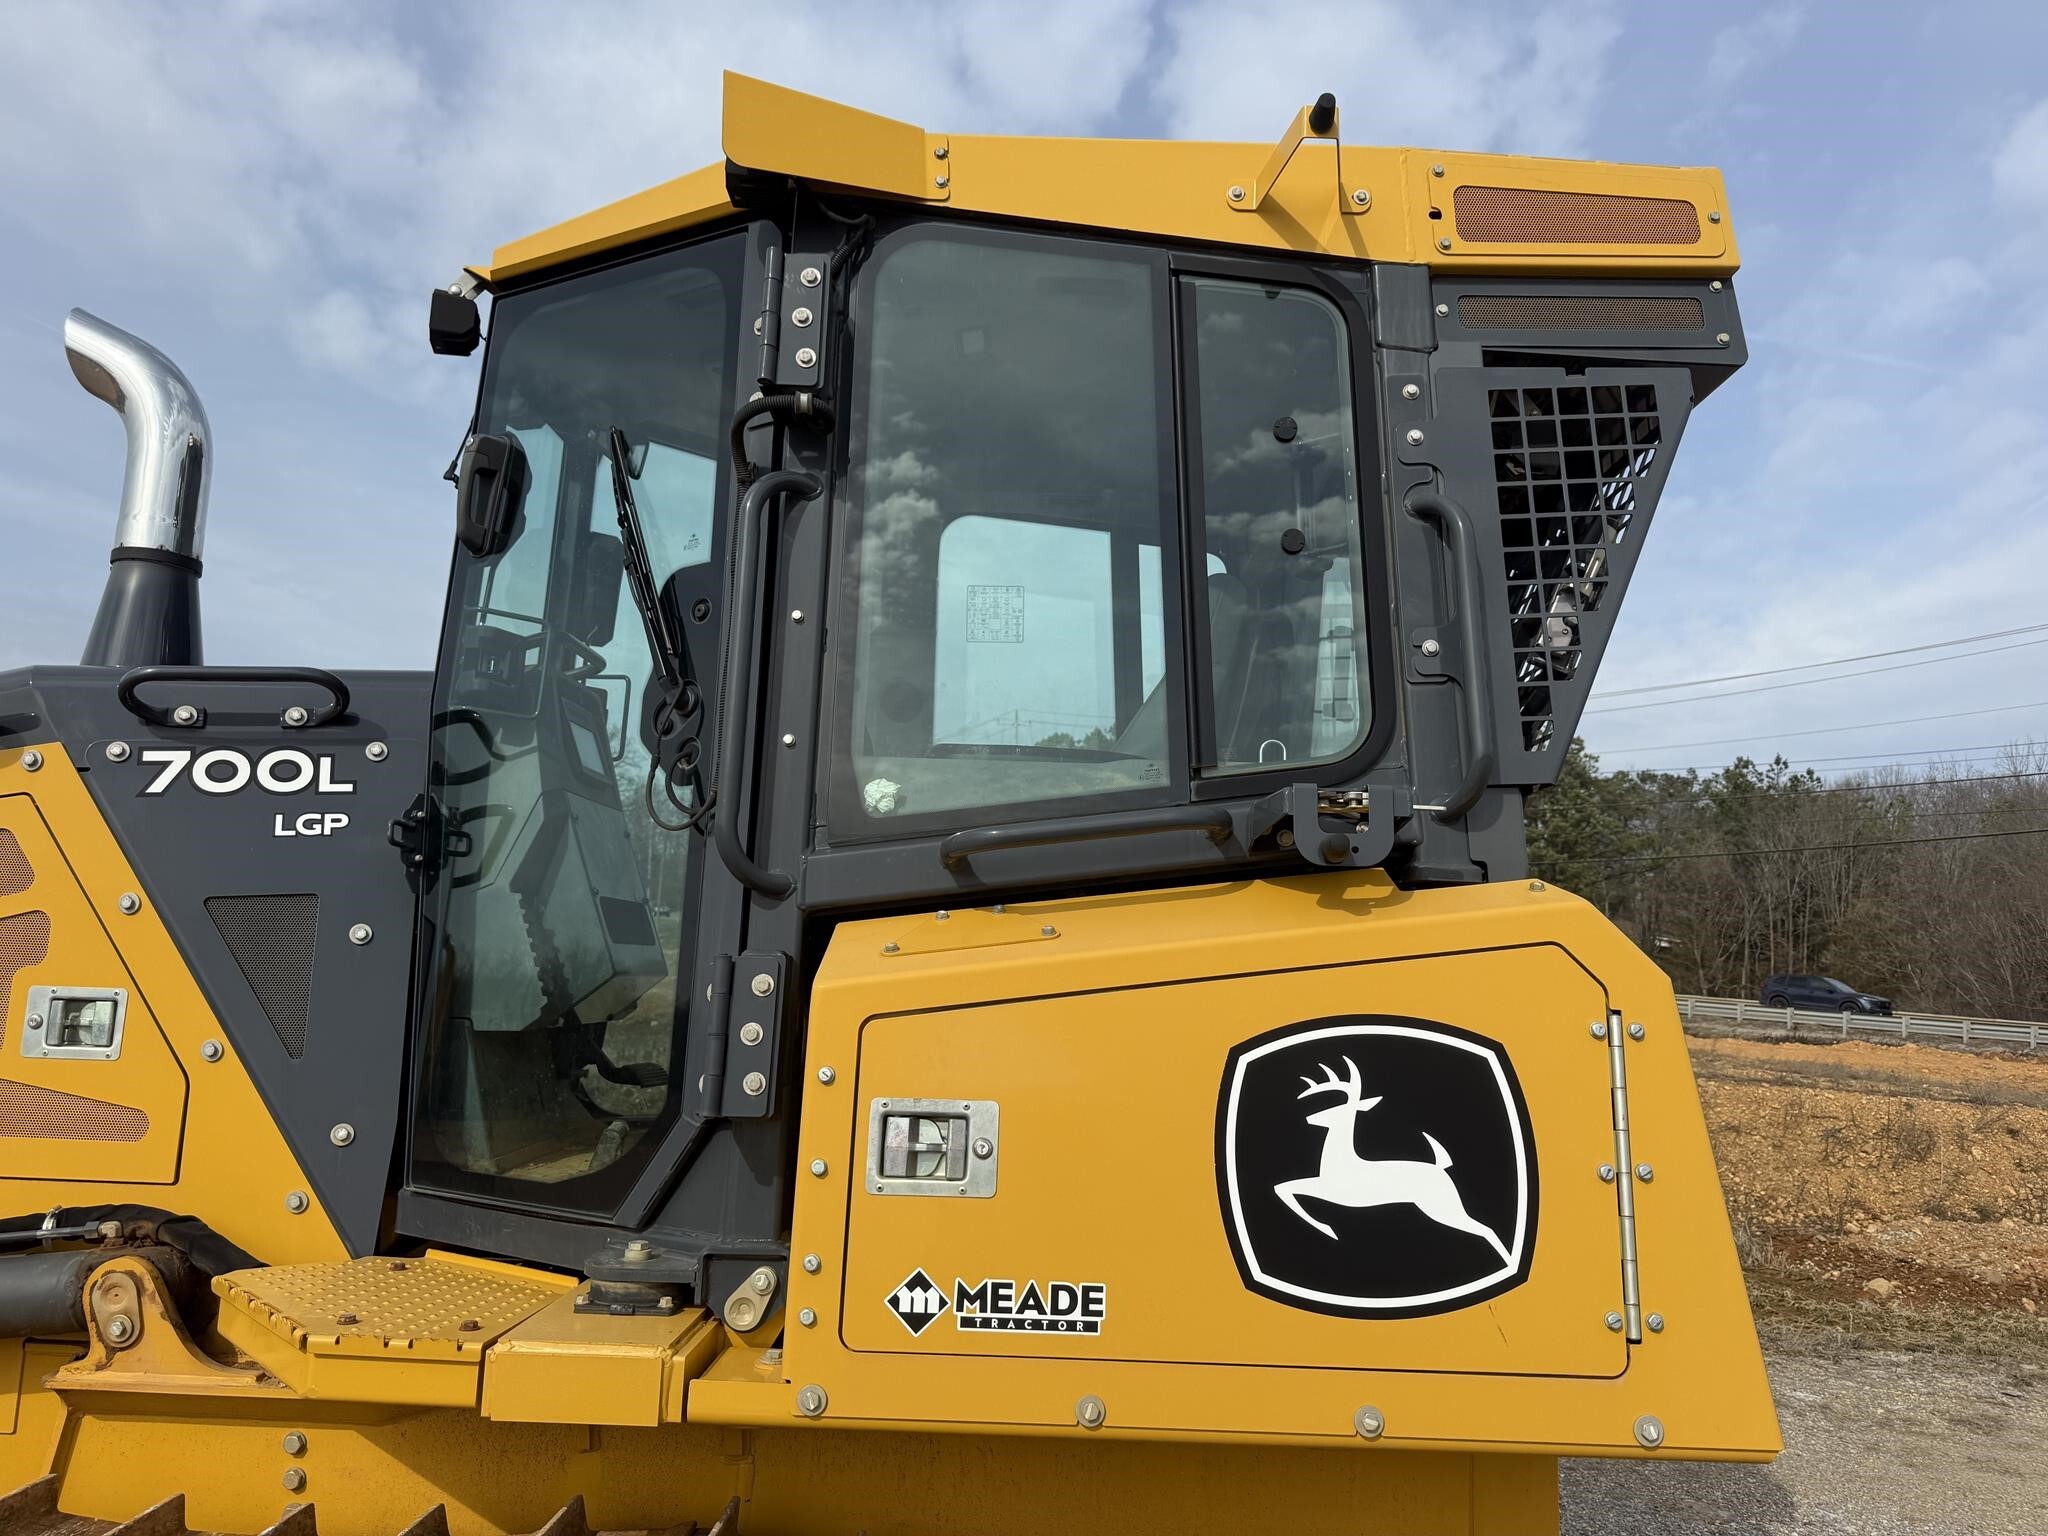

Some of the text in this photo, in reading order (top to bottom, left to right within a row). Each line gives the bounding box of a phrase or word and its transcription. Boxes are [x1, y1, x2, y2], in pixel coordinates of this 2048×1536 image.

[141, 749, 355, 794] 700L
[274, 812, 350, 837] LGP
[955, 1279, 1104, 1318] MEADE
[974, 1317, 1084, 1331] TRACTOR
